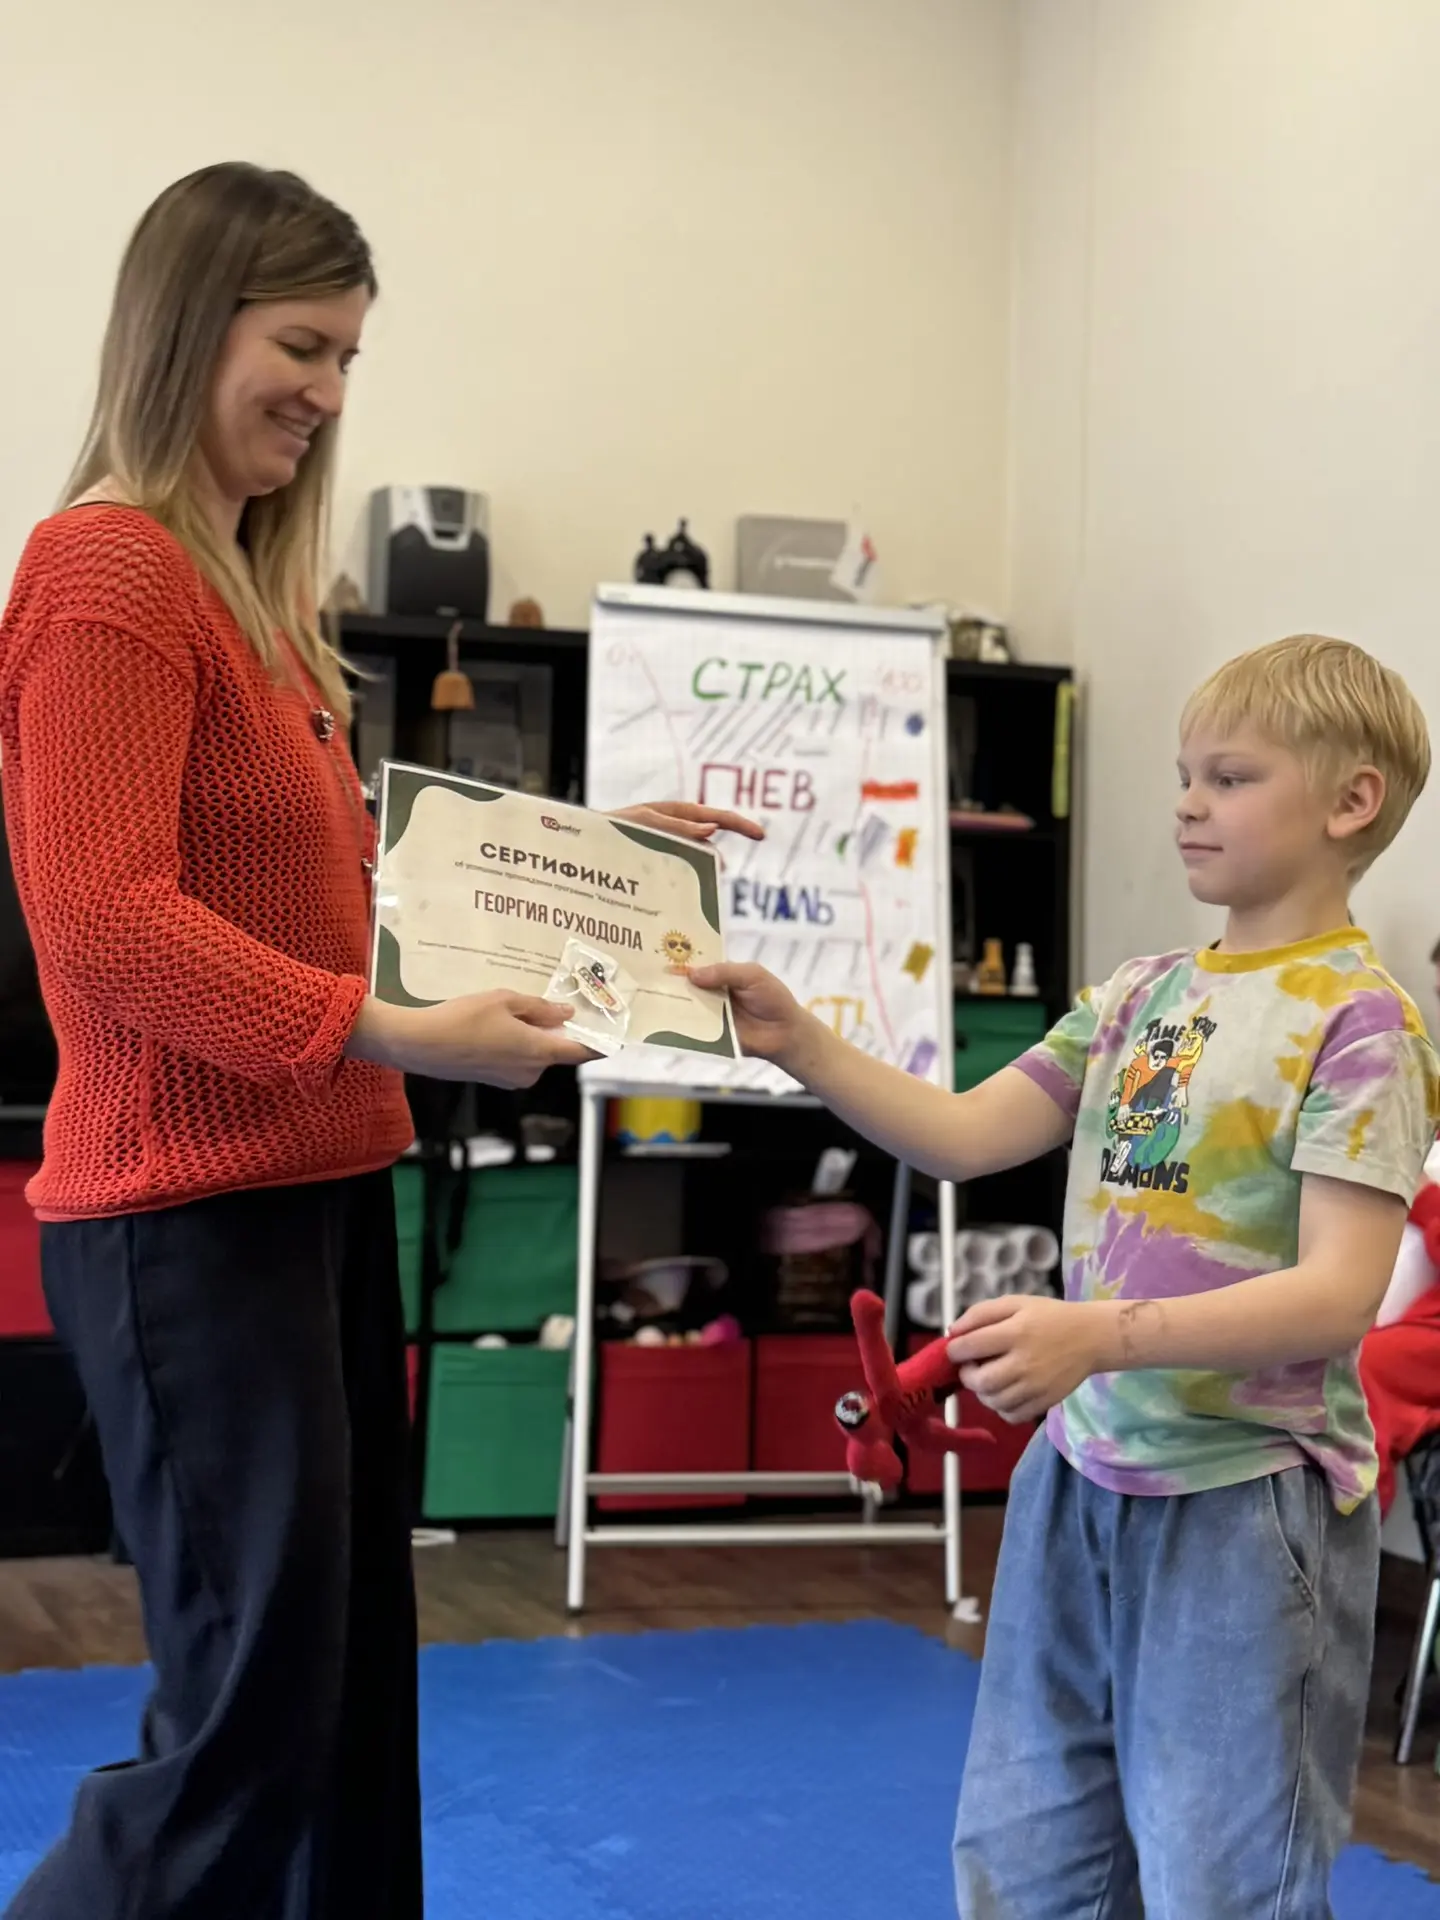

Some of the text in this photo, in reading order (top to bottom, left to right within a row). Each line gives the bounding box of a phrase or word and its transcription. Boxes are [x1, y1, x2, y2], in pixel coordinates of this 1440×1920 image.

[692, 657, 848, 705] СТРАХ
[698, 763, 818, 812] ГНЕВ
[480, 842, 640, 896] СЕРТИФИКАТ
[474, 889, 548, 924] ГЕОРГИЯ
[552, 907, 643, 951] СУХОДОЛА
[730, 876, 836, 927] ЕЧАЛЬ
[1144, 1016, 1187, 1042] TAME
